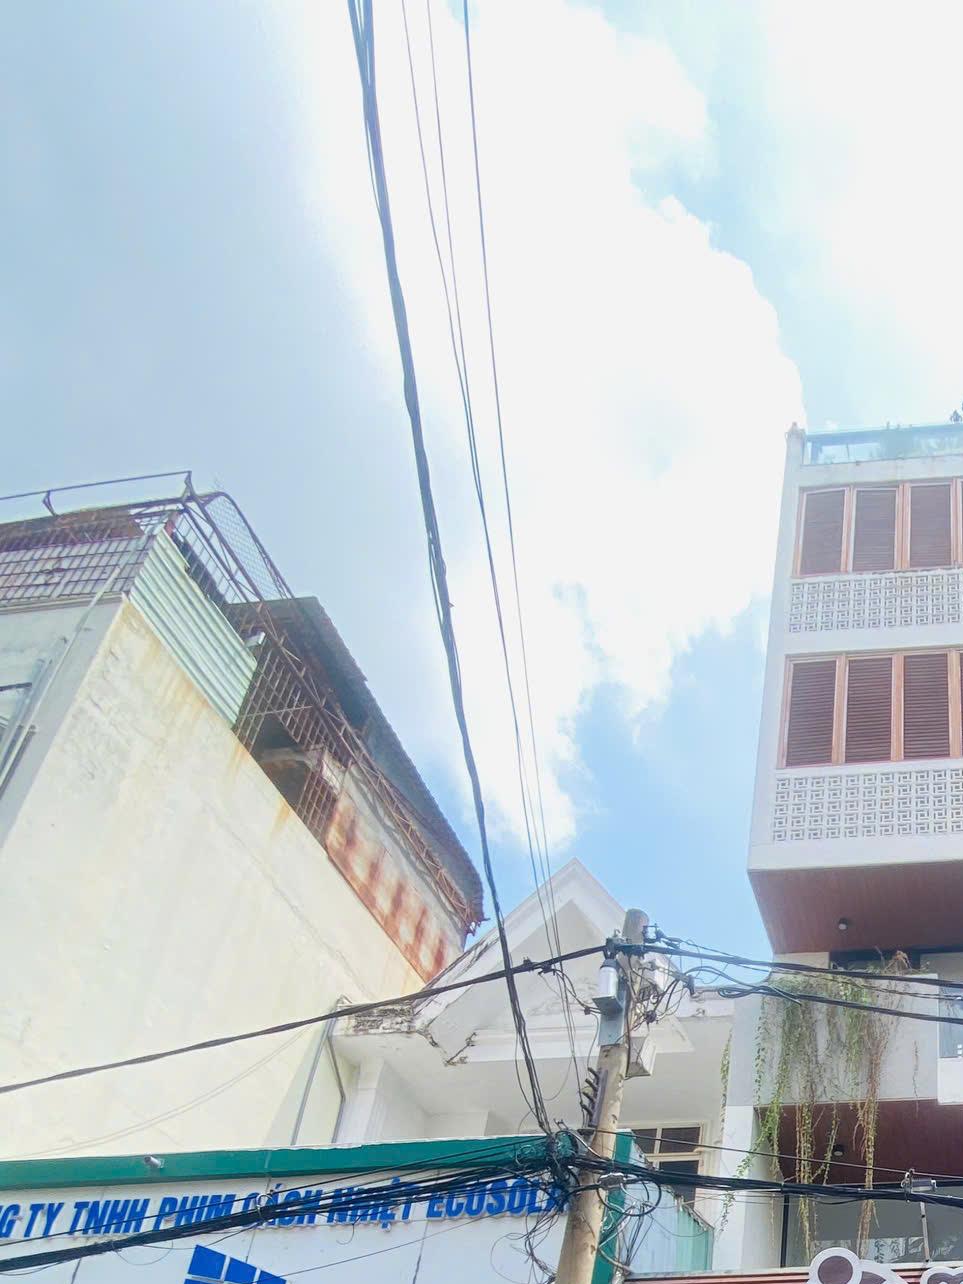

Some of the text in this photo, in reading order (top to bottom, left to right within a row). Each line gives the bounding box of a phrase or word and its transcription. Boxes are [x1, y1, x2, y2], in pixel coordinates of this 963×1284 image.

[0, 1203, 21, 1239] G
[24, 1202, 65, 1238] TY
[69, 1197, 150, 1236] TNHH
[153, 1193, 236, 1232] PHIM
